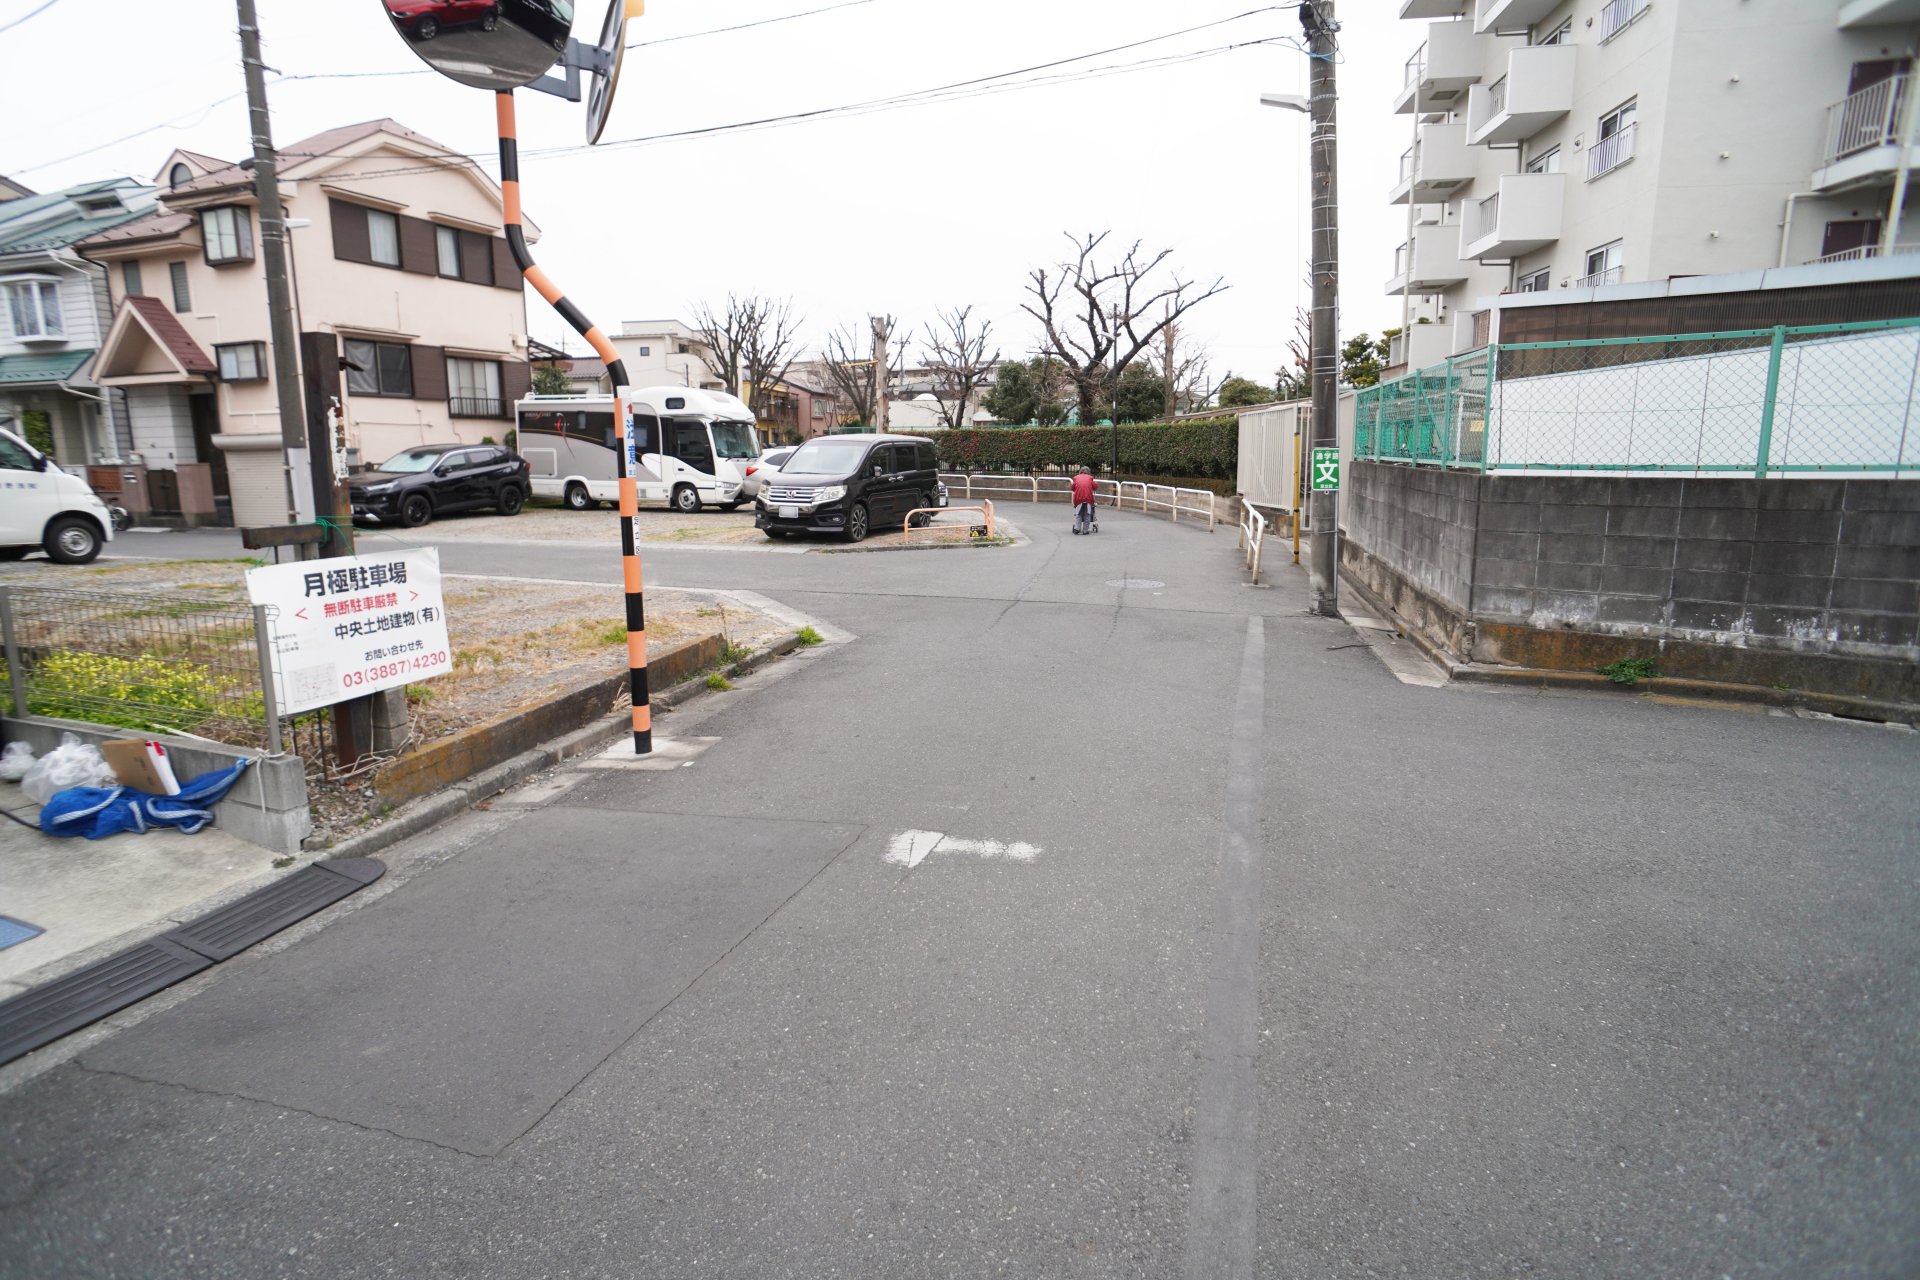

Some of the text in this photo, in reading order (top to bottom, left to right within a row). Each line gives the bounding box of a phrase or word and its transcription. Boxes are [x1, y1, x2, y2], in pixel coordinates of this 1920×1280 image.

[1316, 460, 1338, 483] 文
[304, 561, 407, 597] 月極駐車場
[324, 592, 398, 618] 無断駐車厳禁
[334, 606, 441, 640] 中央土地建物(有)
[364, 639, 424, 662] お問い合わせ先
[343, 650, 446, 688] 03(3887)4230
